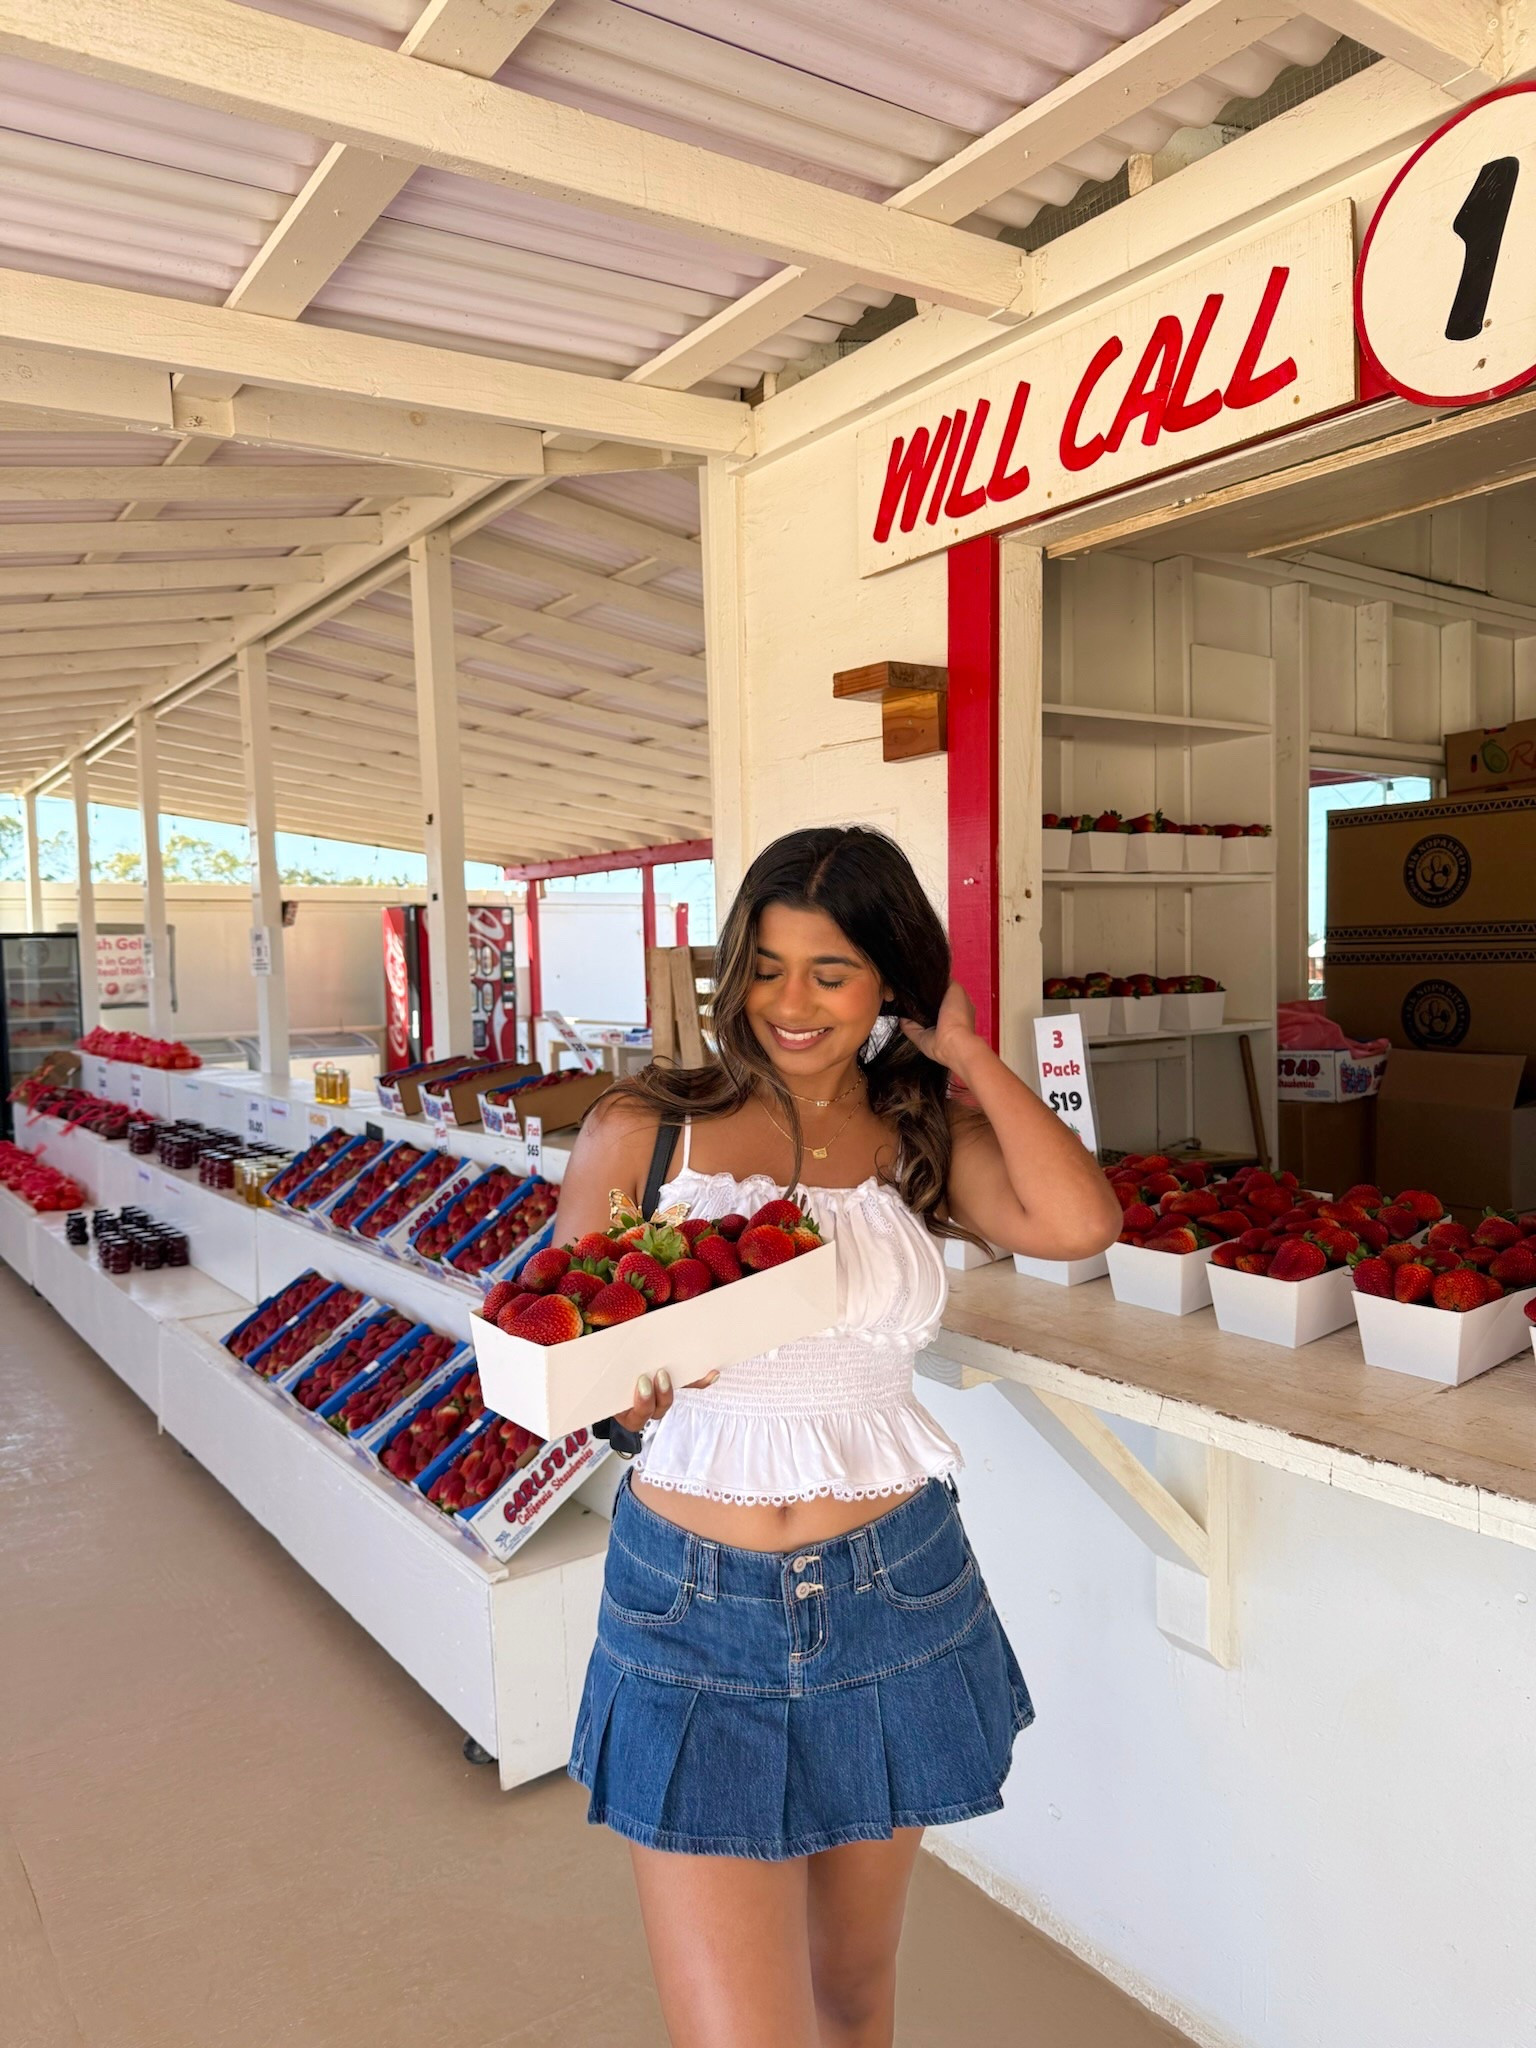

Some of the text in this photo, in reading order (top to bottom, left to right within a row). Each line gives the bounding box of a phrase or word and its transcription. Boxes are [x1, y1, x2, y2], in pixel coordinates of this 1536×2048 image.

[1445, 156, 1520, 342] 1
[873, 265, 1298, 543] WILL CALL
[1052, 1030, 1064, 1049] 3
[1042, 1060, 1081, 1078] Pack
[1049, 1090, 1083, 1114] $19
[527, 1124, 541, 1137] Flat
[527, 1143, 540, 1157] $65
[503, 1427, 589, 1523] CARLSBAD
[517, 1488, 554, 1525] California
[551, 1448, 594, 1491] Strawberries
